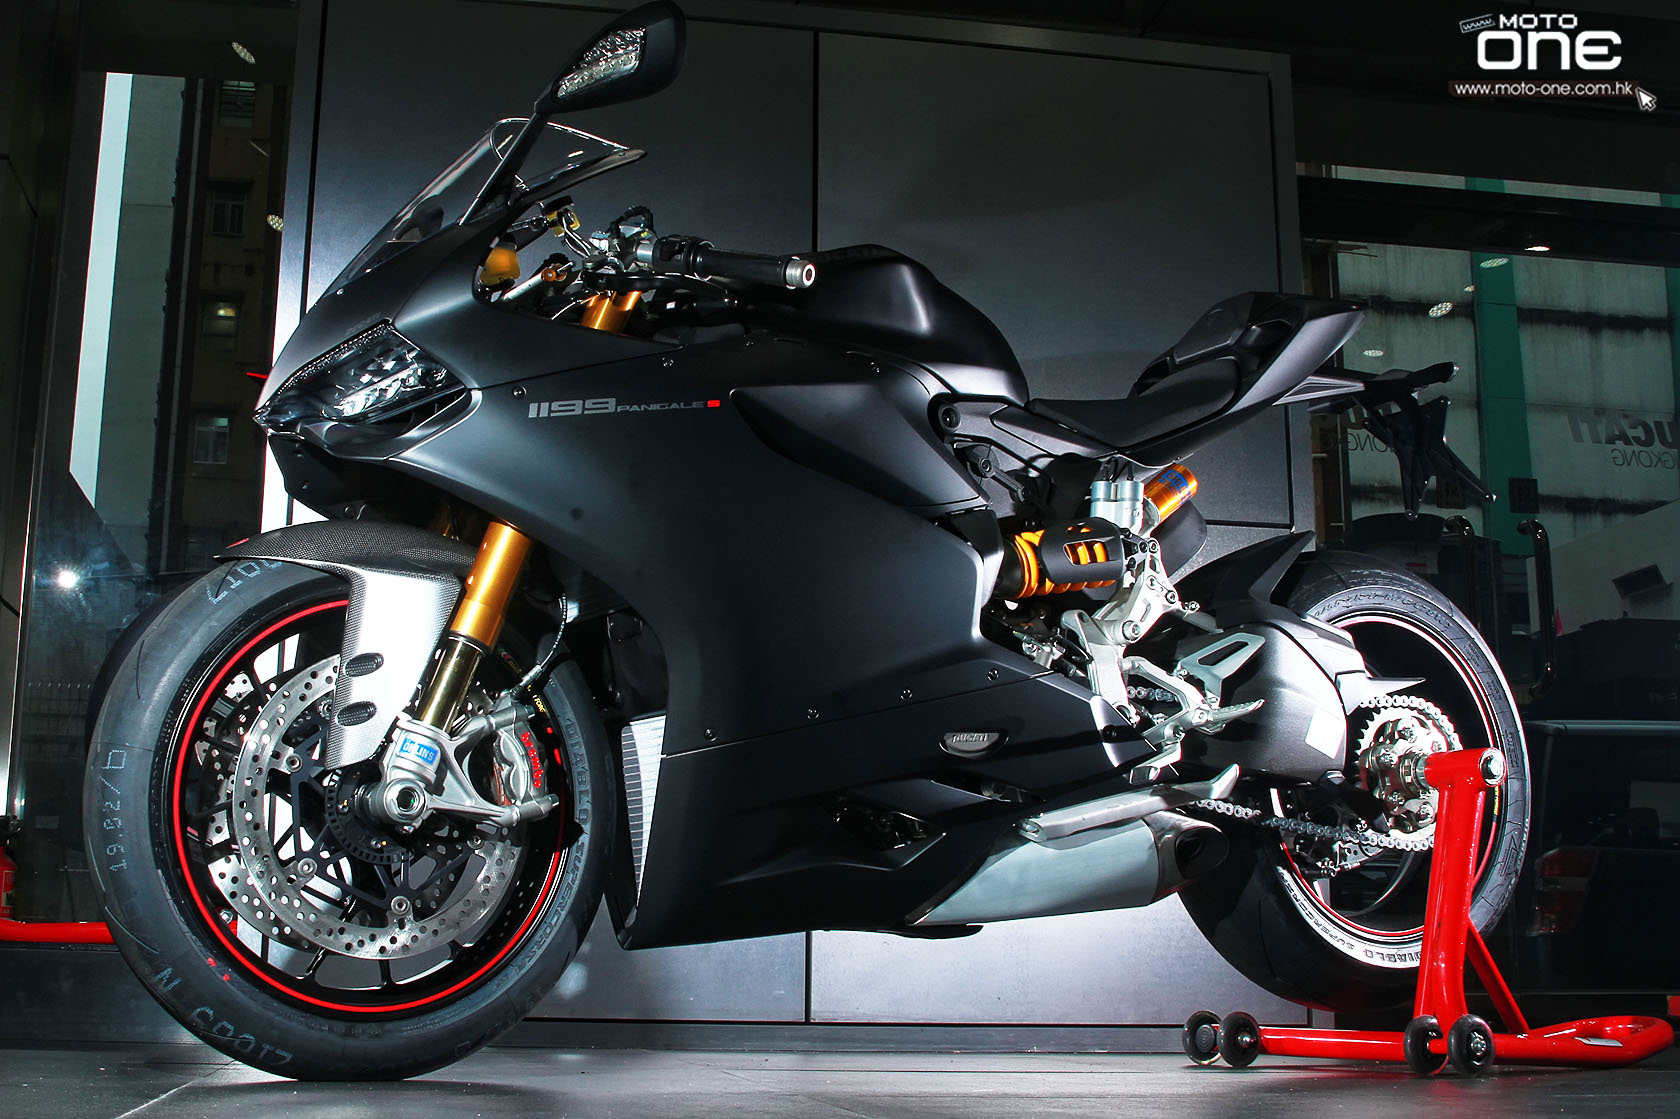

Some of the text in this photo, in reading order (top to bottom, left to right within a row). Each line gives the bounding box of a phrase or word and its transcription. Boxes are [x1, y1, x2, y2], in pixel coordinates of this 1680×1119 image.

[528, 397, 617, 418] 1199
[617, 400, 705, 413] PANIGALE
[520, 731, 544, 789] brembo
